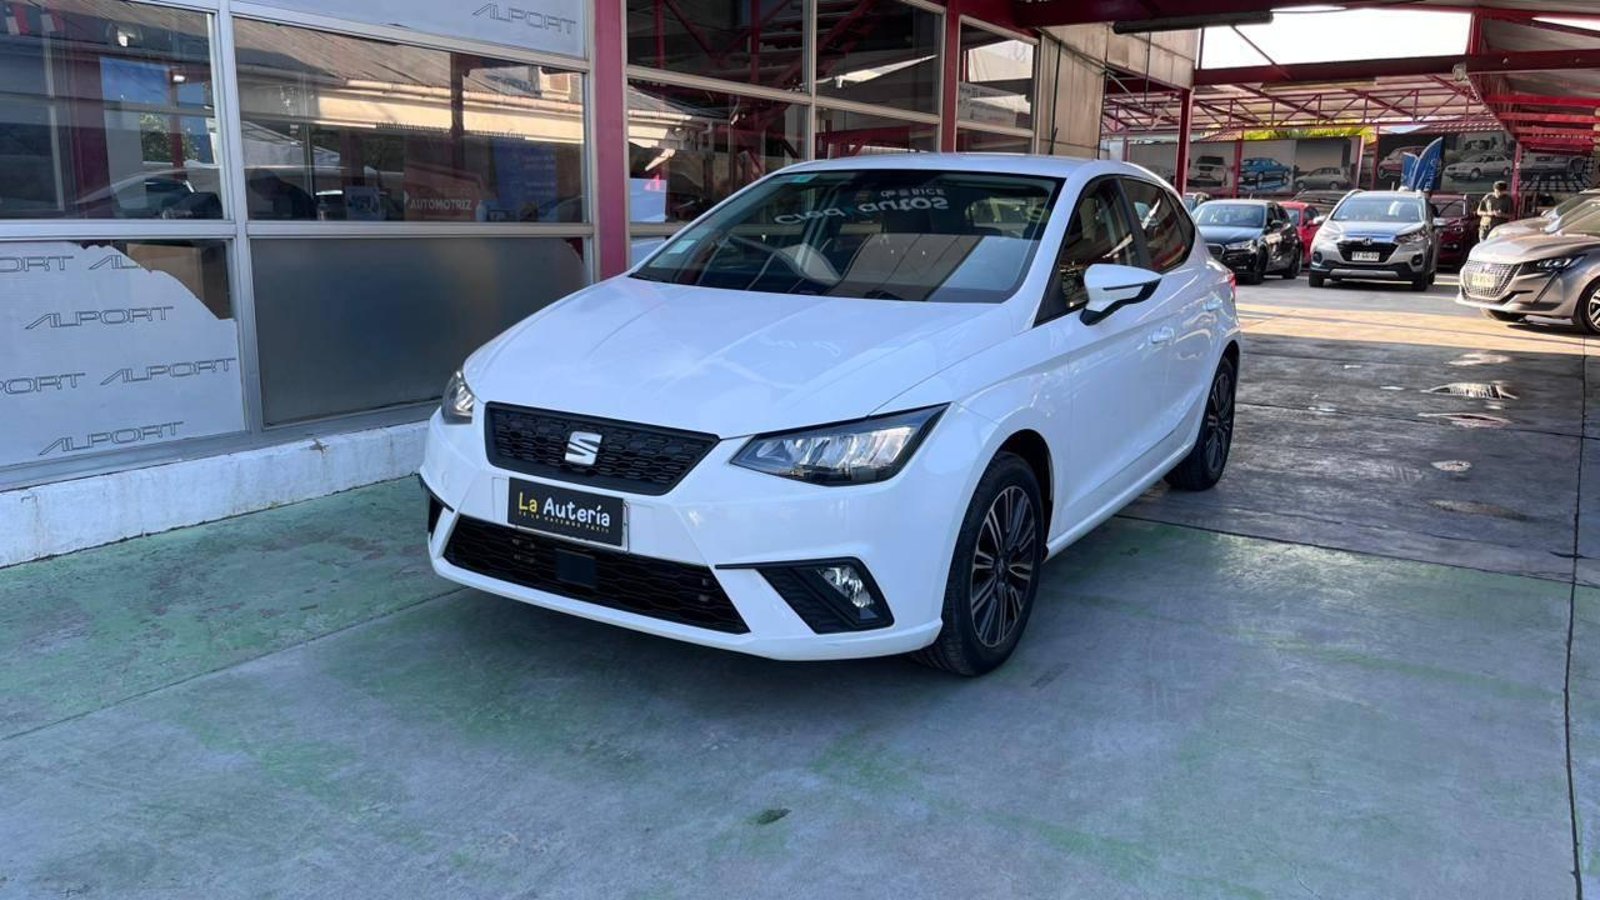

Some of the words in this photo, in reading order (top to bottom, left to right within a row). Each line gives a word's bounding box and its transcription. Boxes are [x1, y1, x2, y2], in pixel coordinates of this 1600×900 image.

[472, 3, 576, 34] ALPORT
[410, 199, 472, 210] AUTOMOTRIZ
[25, 306, 174, 330] ALPORT
[0, 373, 86, 395] ORT
[100, 358, 237, 385] ALPORT
[38, 421, 184, 456] ALPORT
[518, 491, 538, 513] La
[543, 497, 610, 527] Autería
